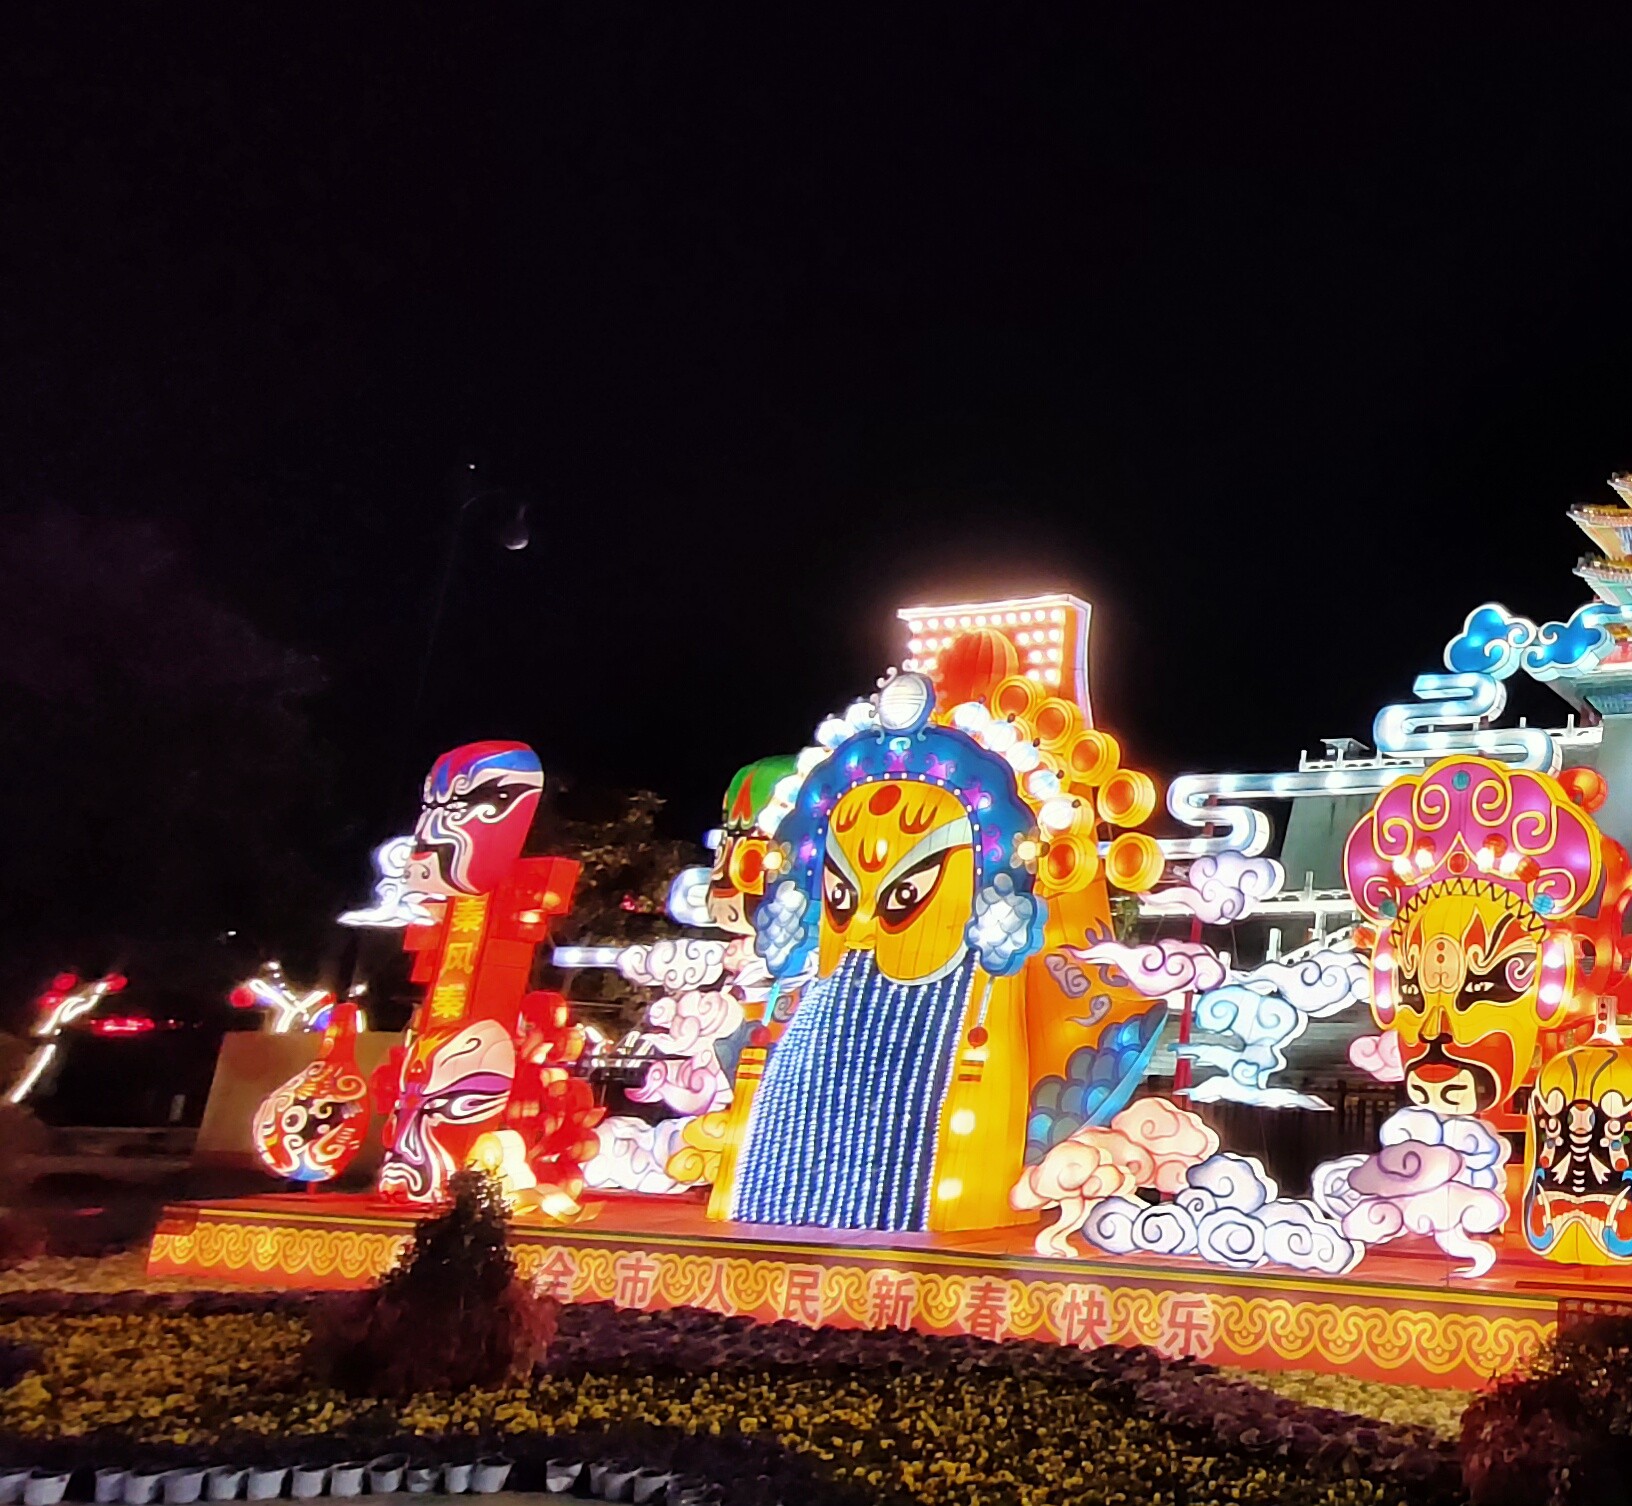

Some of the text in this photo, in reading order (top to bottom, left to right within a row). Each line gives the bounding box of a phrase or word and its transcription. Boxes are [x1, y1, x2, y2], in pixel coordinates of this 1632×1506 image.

[536, 1250, 1219, 1358] 全市人民新春快乐
